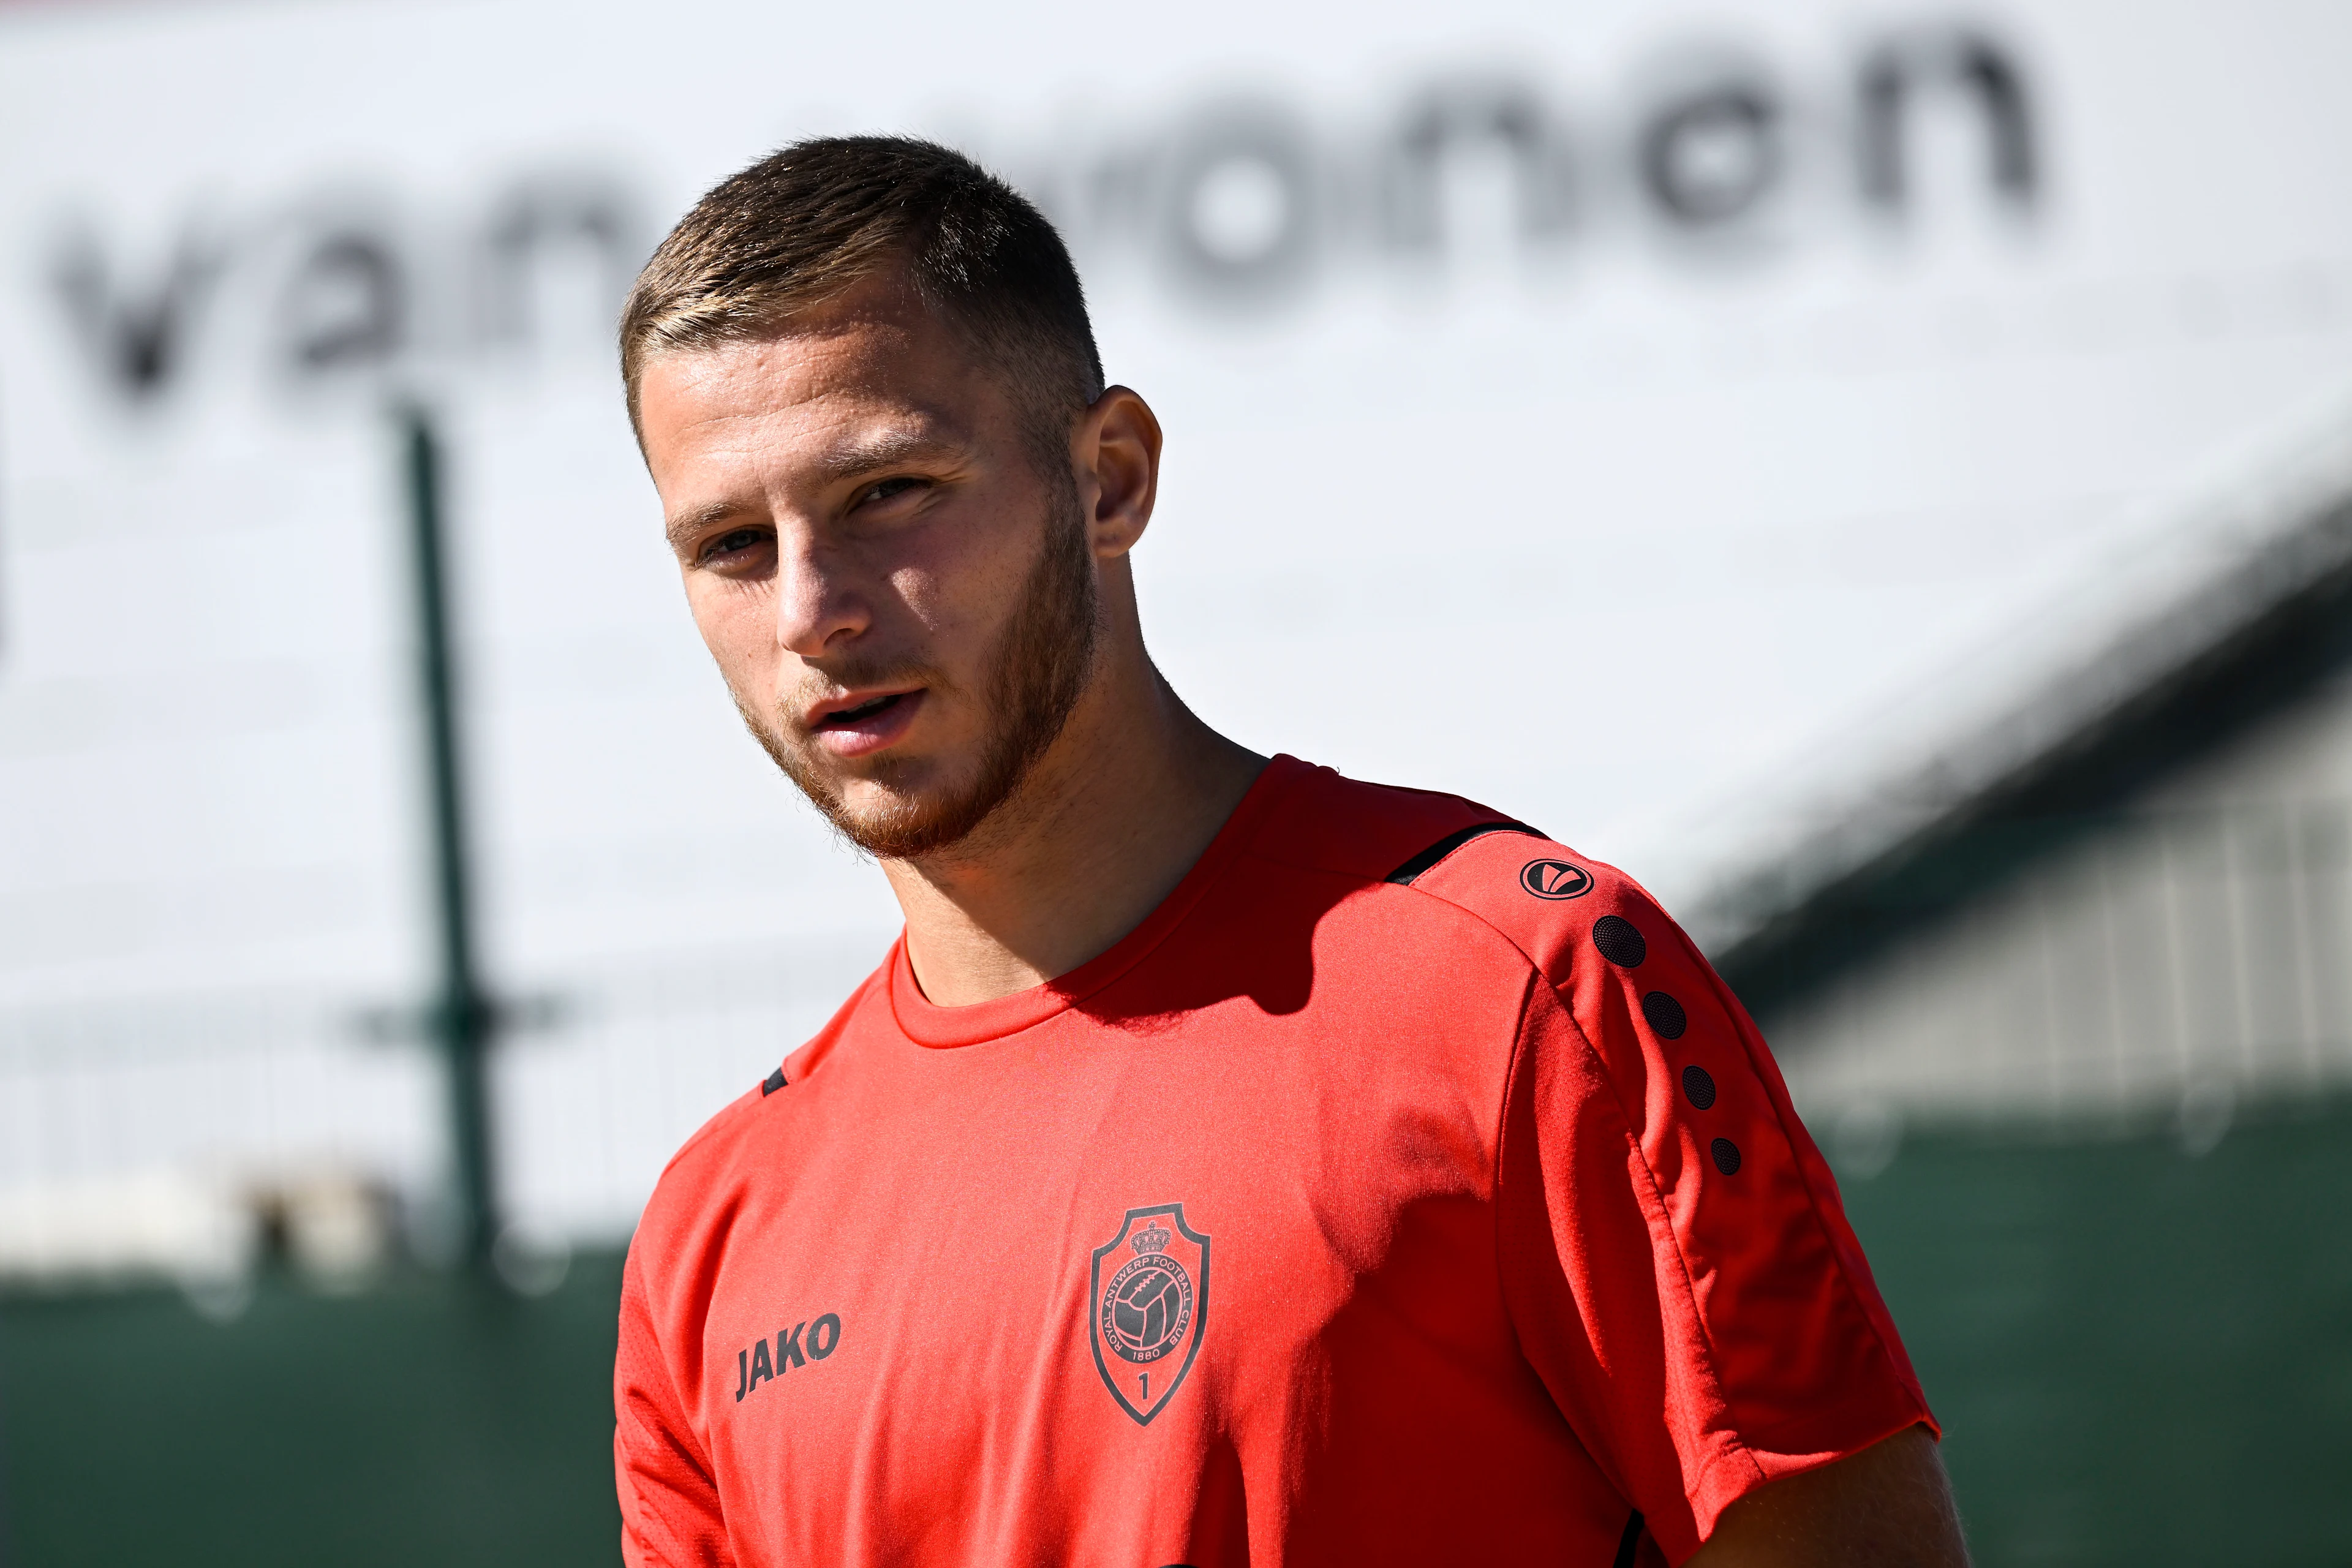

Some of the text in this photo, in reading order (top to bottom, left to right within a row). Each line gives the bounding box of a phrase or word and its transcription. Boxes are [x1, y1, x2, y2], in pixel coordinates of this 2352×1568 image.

[46, 172, 658, 407] van
[1103, 1256, 1191, 1352] ROYAL ANTWERP FOOTBALL CLUB
[736, 1312, 841, 1403] JAKO
[1133, 1348, 1160, 1361] 1880
[1138, 1372, 1149, 1400] 1
